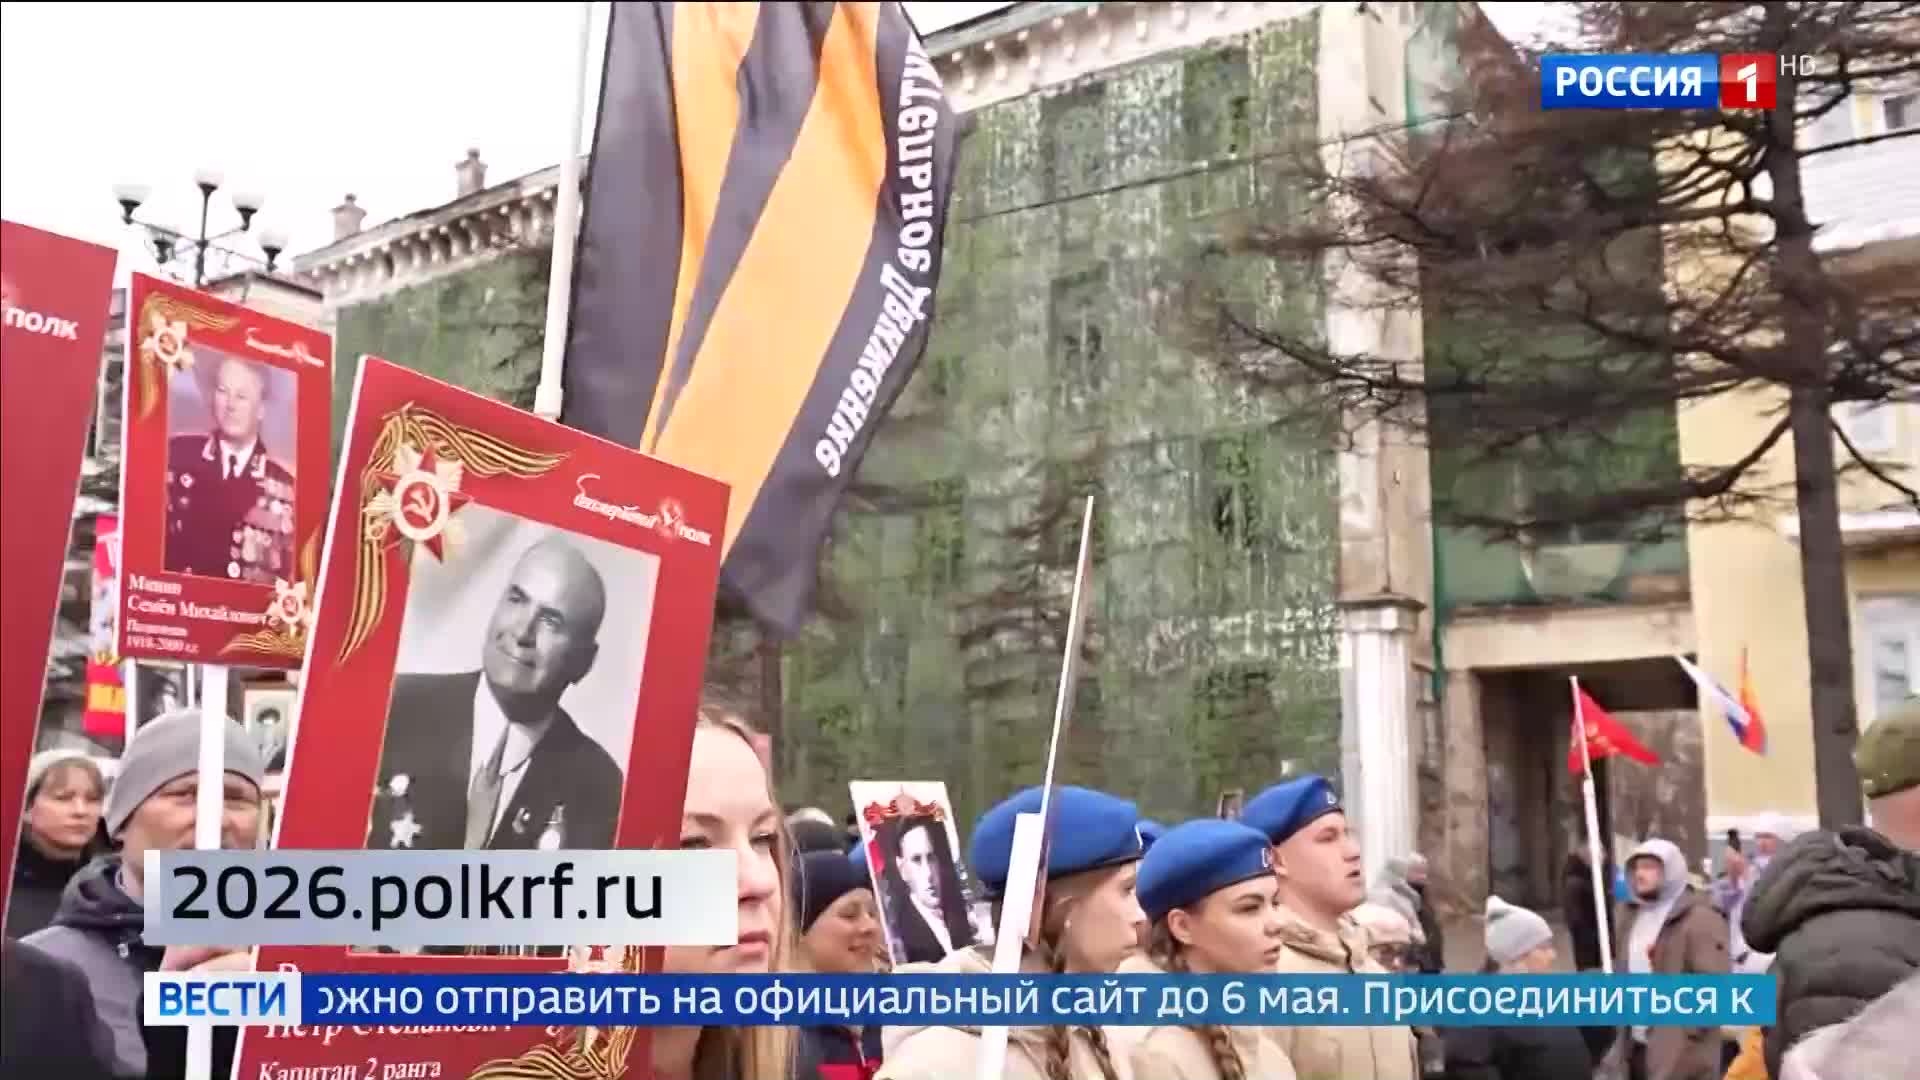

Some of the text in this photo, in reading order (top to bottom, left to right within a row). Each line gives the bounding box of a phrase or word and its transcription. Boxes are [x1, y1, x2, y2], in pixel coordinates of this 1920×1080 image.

[6, 307, 79, 340] полк
[364, 1057, 377, 1080] 2
[383, 1061, 441, 1080] ранга
